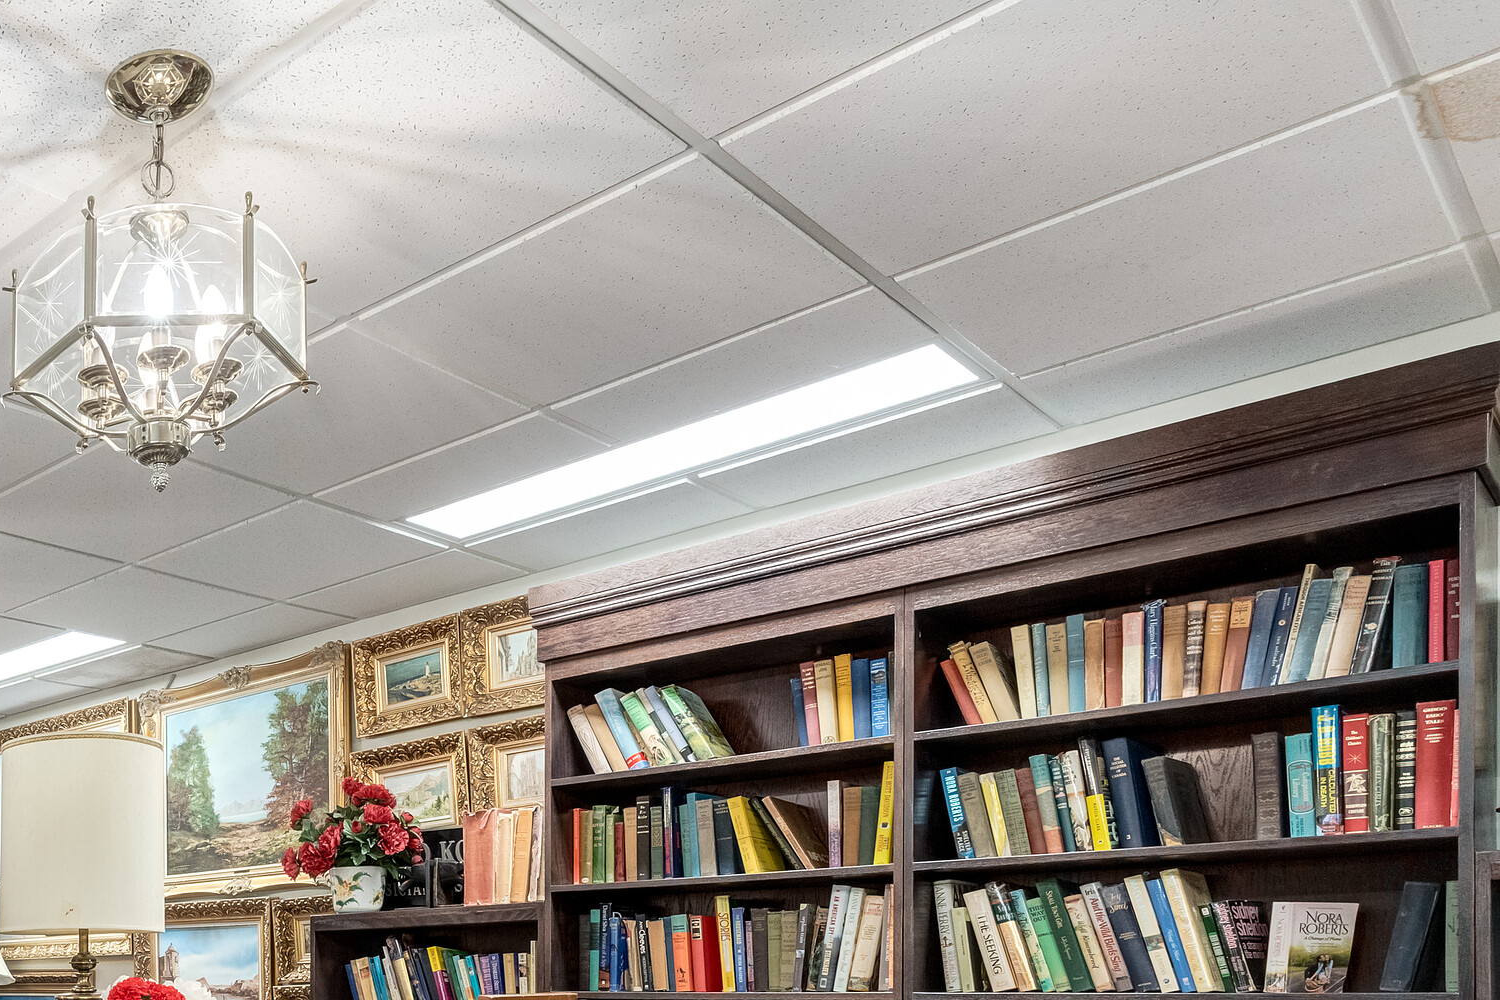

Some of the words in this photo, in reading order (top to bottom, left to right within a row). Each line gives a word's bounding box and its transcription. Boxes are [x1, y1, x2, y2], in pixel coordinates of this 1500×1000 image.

[1150, 602, 1158, 617] Mary
[1295, 600, 1305, 622] AFRICAN
[1149, 619, 1159, 641] Higgins
[1150, 642, 1159, 659] Clark
[1319, 738, 1336, 765] ROBB
[885, 781, 893, 794] MOTT
[945, 776, 958, 794] NORA
[1292, 778, 1300, 797] Library
[1328, 770, 1337, 813] CALCULATED
[883, 795, 891, 817] DAVIDSON
[948, 794, 964, 822] ROBERTS
[962, 831, 972, 851] SHELTER
[935, 886, 948, 908] ANNE
[1045, 890, 1056, 905] SMALL
[1051, 905, 1059, 917] TOWN
[1090, 898, 1100, 912] And
[830, 904, 838, 925] AMERICAN
[1096, 912, 1106, 922] the
[1232, 902, 1259, 923] sidney
[1306, 910, 1343, 924] NORA
[717, 913, 730, 942] STORIES
[937, 912, 951, 935] PERRY
[977, 914, 988, 933] THE
[1099, 922, 1112, 938] Wild
[1218, 903, 1226, 923] sidney
[1222, 923, 1238, 949] sheldon
[1236, 921, 1268, 936] sheldon
[1299, 923, 1349, 935] ROBERTS
[639, 930, 647, 954] Cleeves
[1074, 920, 1086, 934] Well
[1082, 935, 1099, 969] Remembered
[1103, 939, 1116, 955] Birds
[982, 934, 1003, 975] SEEKING
[1110, 955, 1122, 972] Sing
